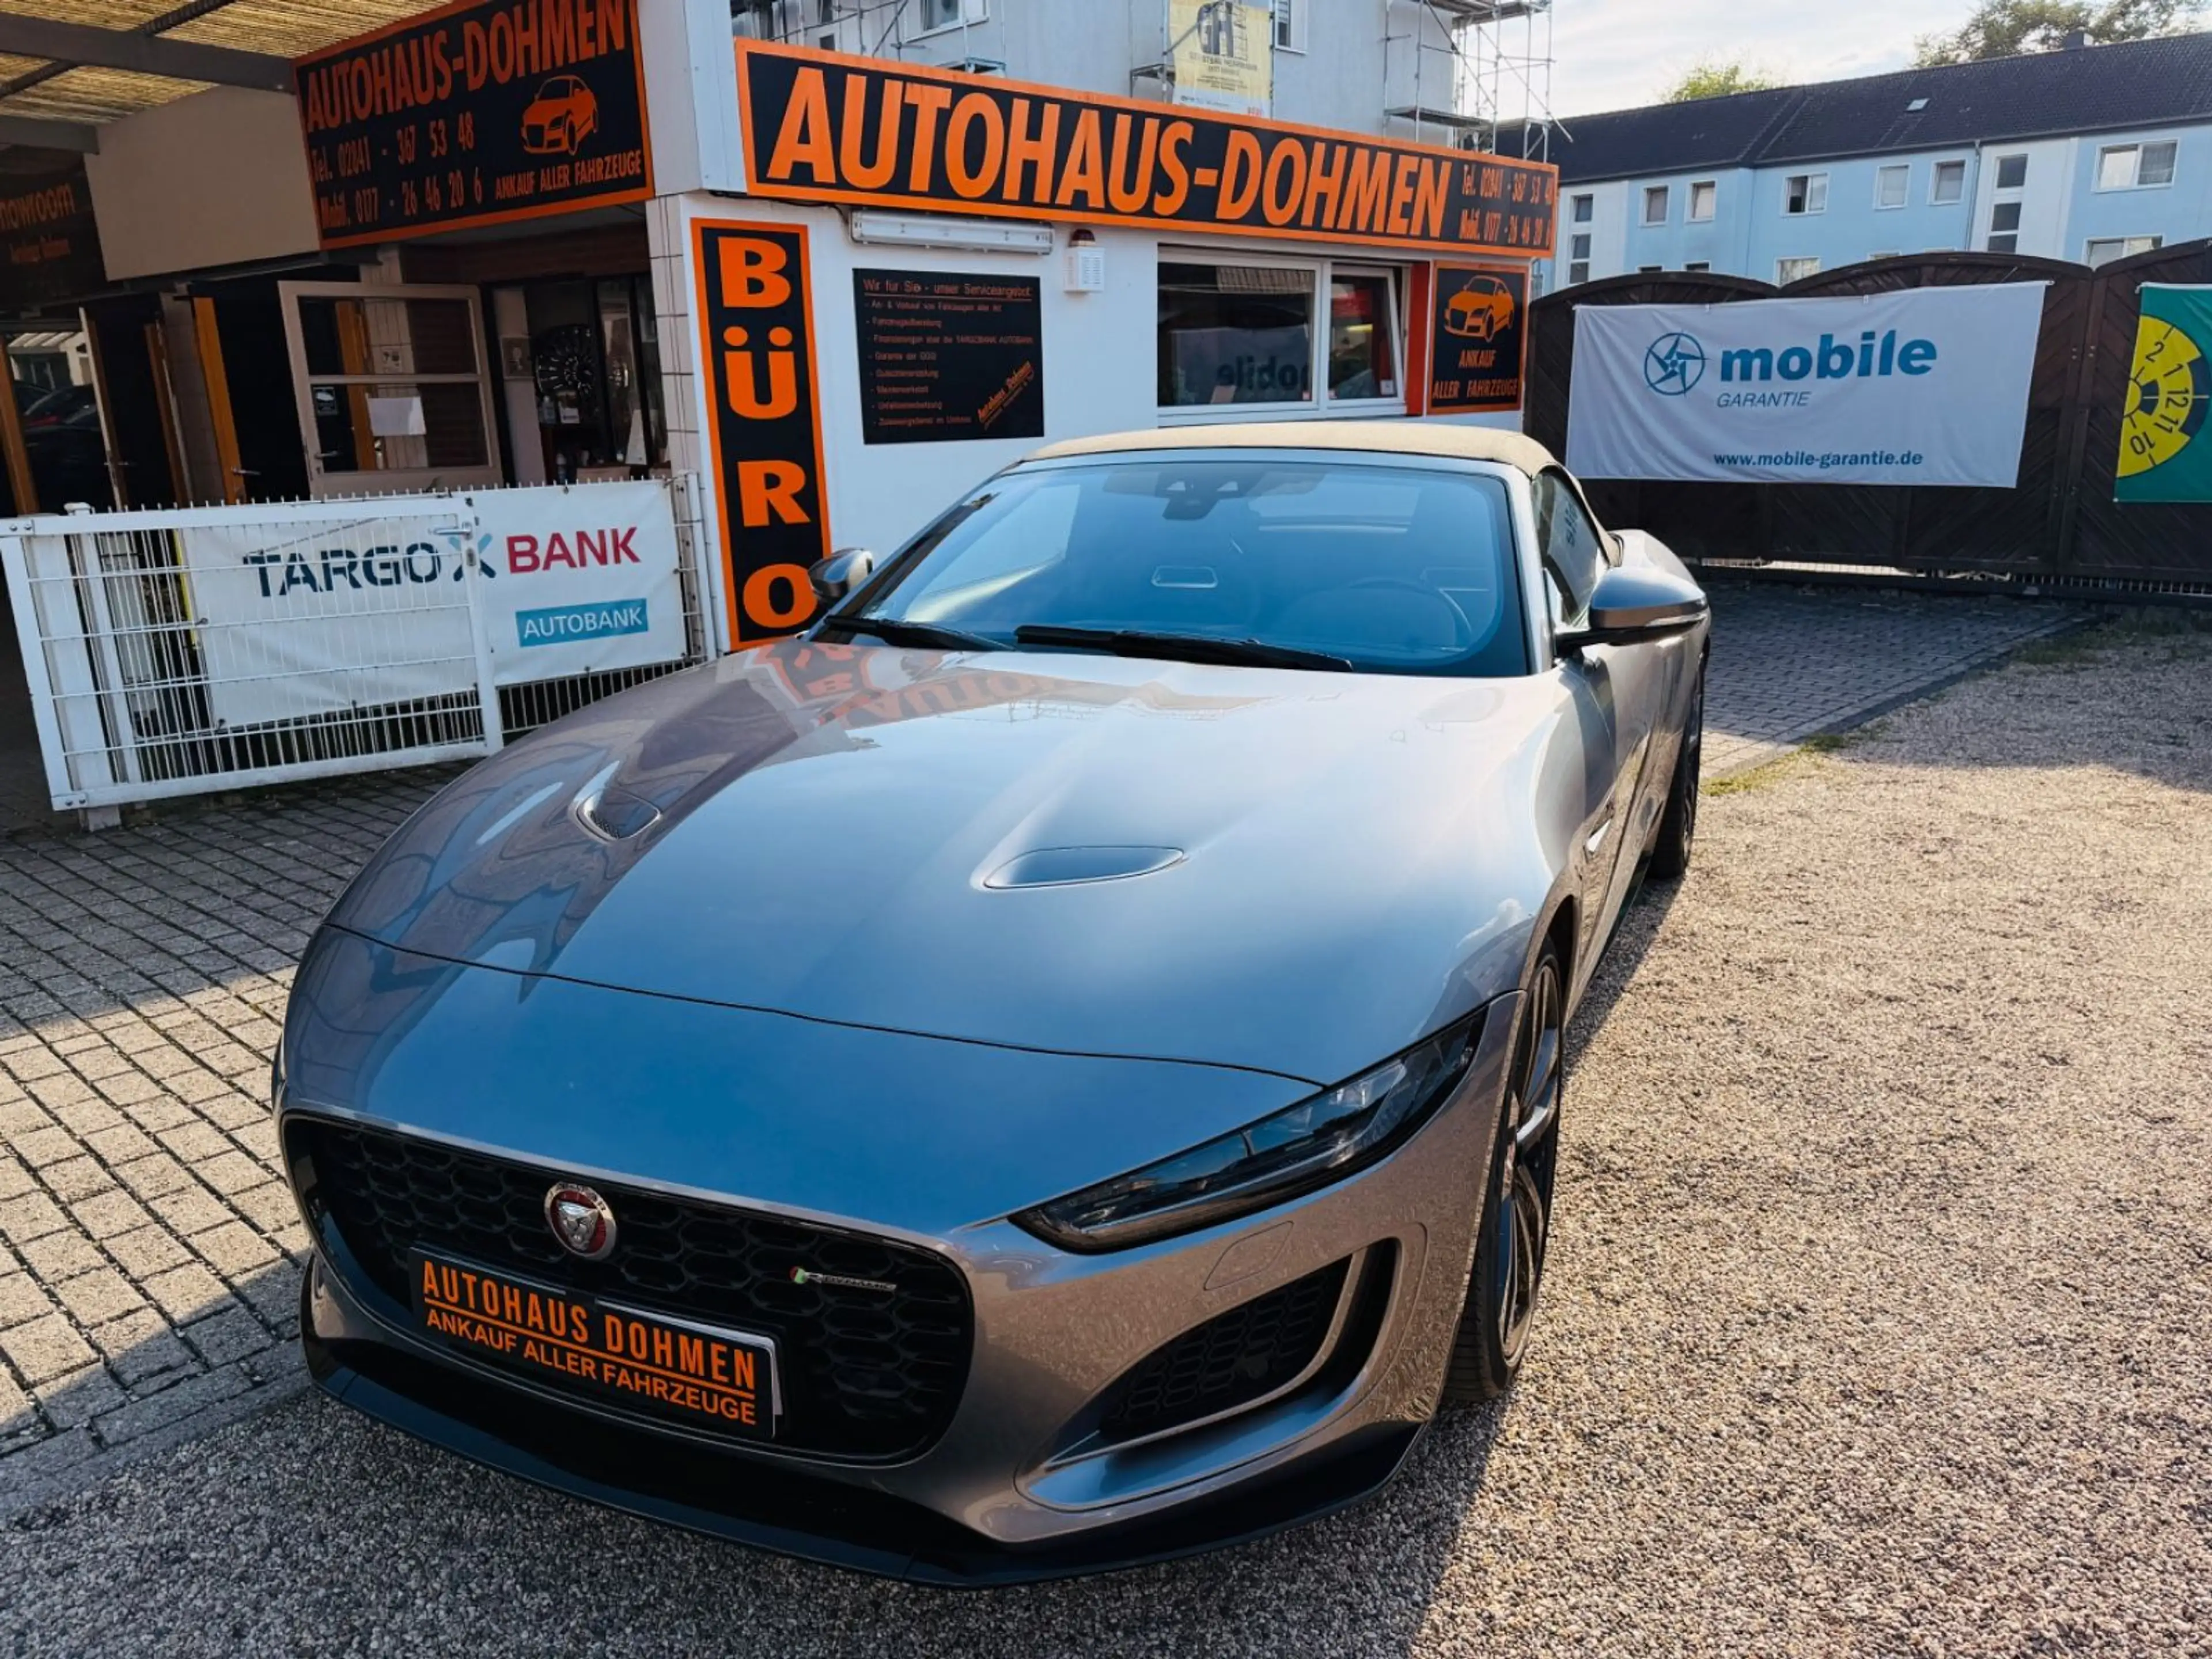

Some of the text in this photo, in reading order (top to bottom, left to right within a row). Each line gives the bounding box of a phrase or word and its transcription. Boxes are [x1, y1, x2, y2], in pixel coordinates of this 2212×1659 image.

[307, 0, 625, 133] AUTOHAUS-DOHMEN
[430, 119, 448, 157] 53
[458, 111, 474, 151] 48
[768, 67, 1452, 238] AUTOHAUS-DOHMEN
[448, 169, 464, 208] 20
[474, 166, 483, 204] 6
[495, 150, 641, 200] ANKAUF ALLER FAHRZEUGE
[1459, 349, 1497, 369] ANKAUF
[1719, 329, 1937, 382] mobile
[2146, 341, 2165, 362] 2
[1433, 378, 1518, 399] ALLER FAHRZEUGE
[1717, 391, 1812, 408] GARANTIE
[718, 236, 817, 629] BÜRO
[1713, 450, 1923, 469] www.mobile-garantie.de
[507, 527, 640, 574] BANK
[524, 607, 643, 638] AUTOBANK
[424, 1261, 756, 1390] AUTOHAUS DOHMEN
[427, 1308, 756, 1425] ANKAUF ALLER FAHRZEUGE
